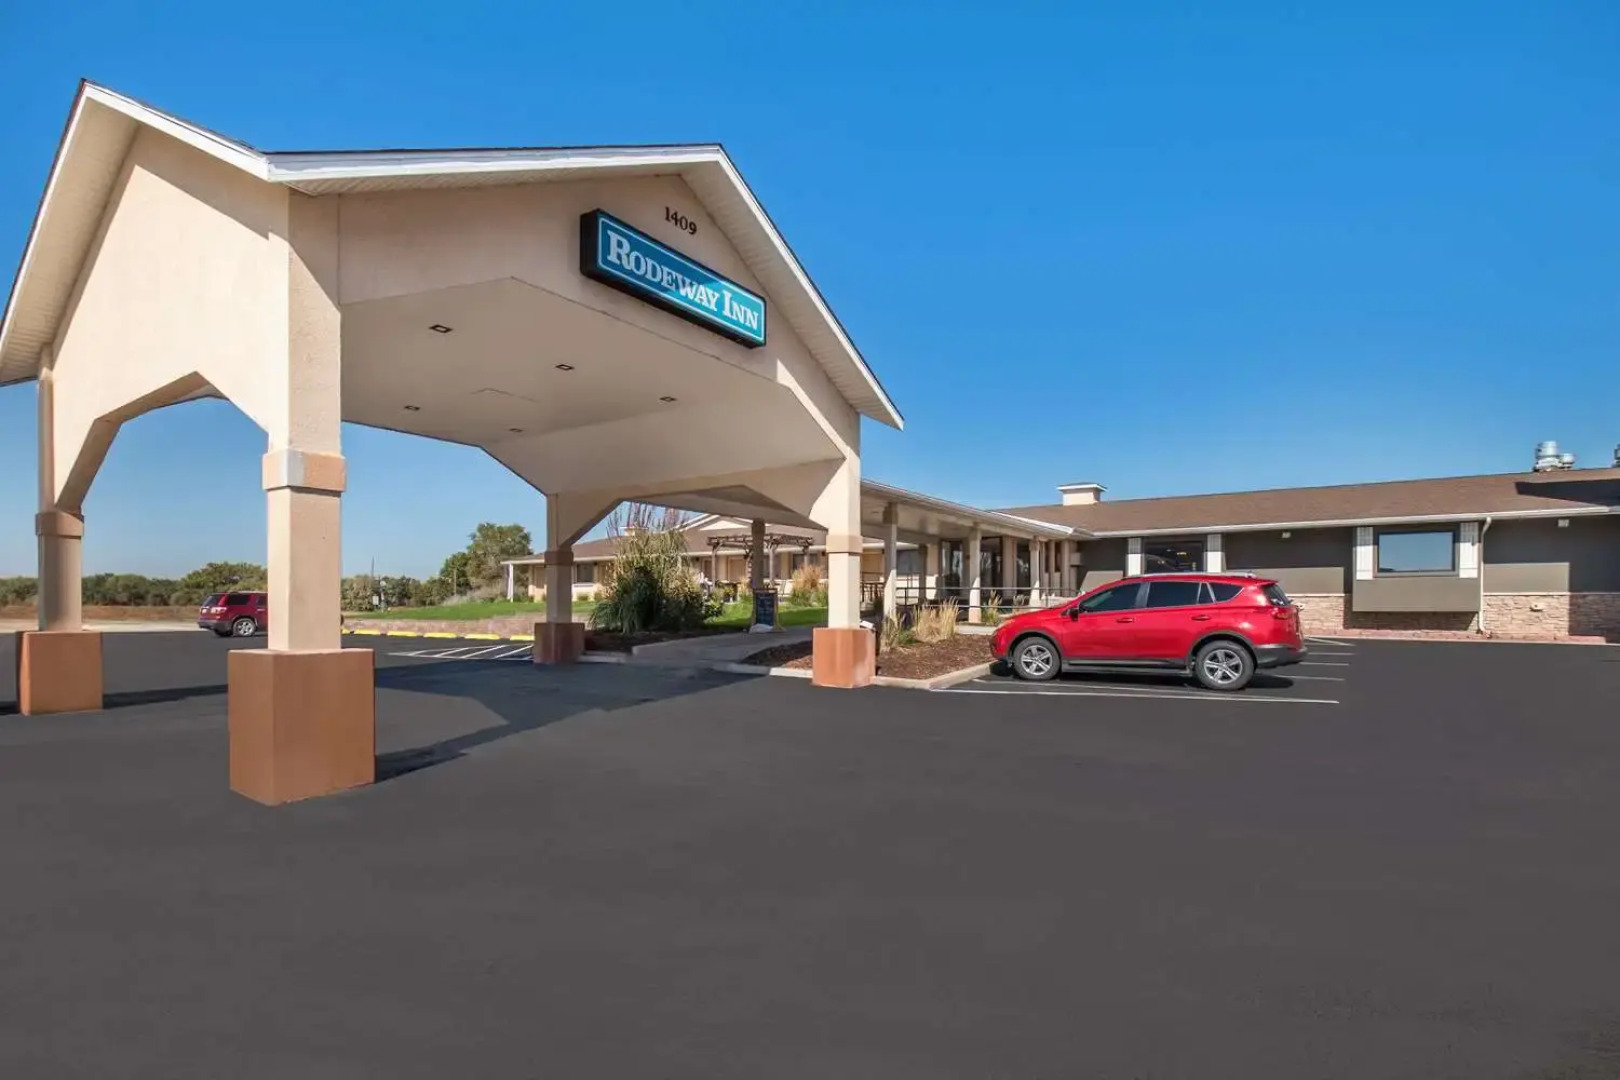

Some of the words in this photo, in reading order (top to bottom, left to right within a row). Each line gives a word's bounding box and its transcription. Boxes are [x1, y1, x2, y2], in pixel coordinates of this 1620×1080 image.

[664, 206, 698, 235] 1409
[606, 229, 720, 312] RODEWAY
[722, 289, 759, 330] INN
